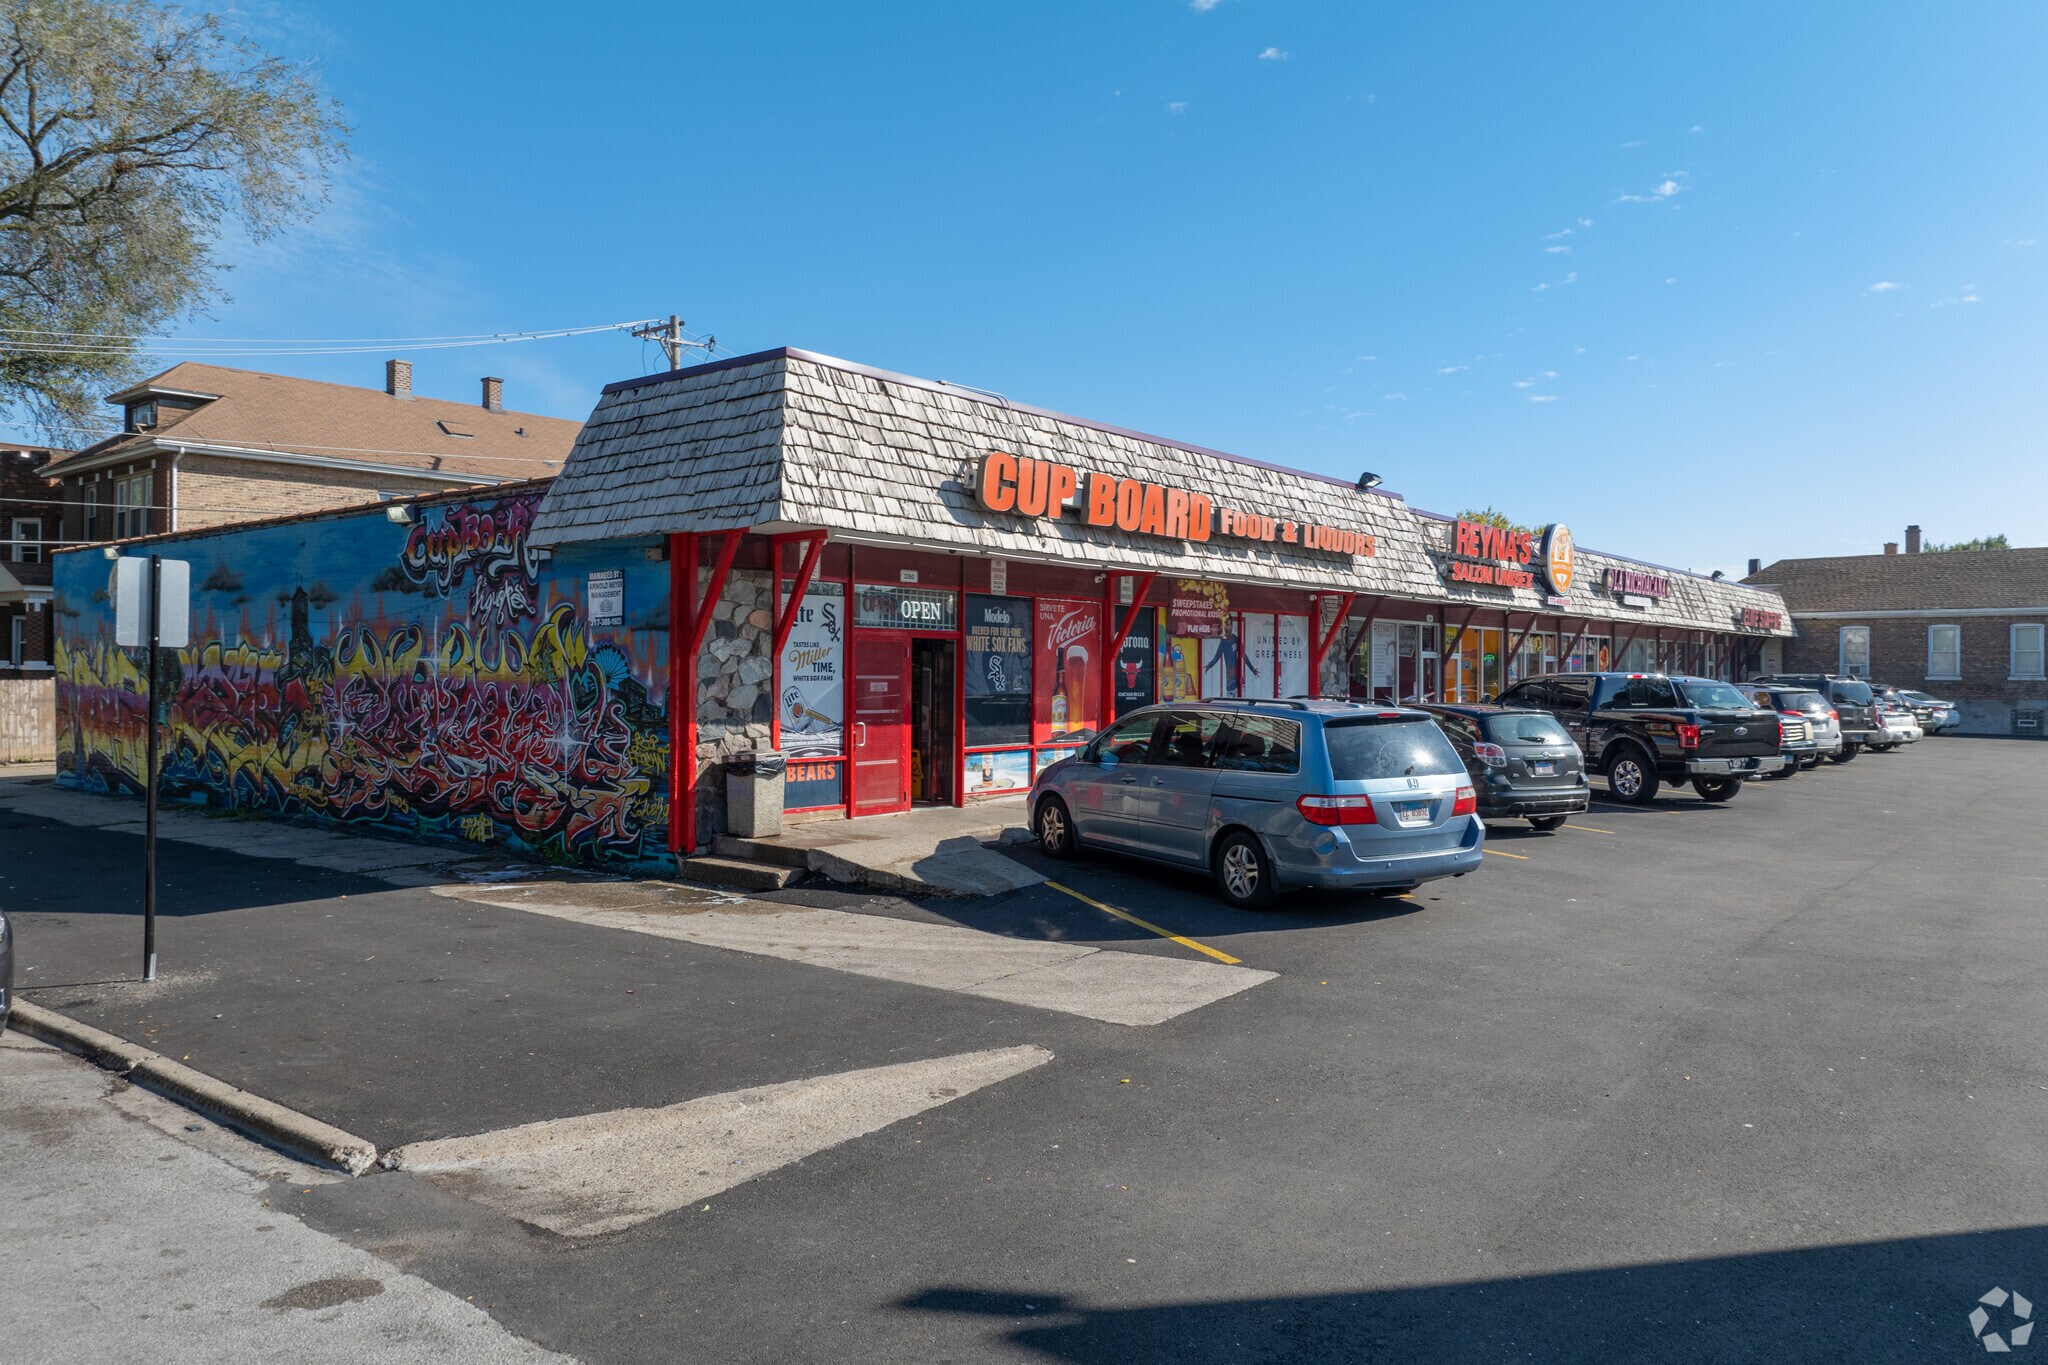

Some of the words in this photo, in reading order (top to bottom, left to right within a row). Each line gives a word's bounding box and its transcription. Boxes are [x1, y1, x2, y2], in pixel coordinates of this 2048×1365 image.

[983, 452, 1077, 519] CUP
[1088, 472, 1212, 542] BOARD
[1221, 507, 1276, 542] FOOD
[1282, 521, 1298, 543] &
[1304, 523, 1376, 558] LIQUORS
[1456, 520, 1532, 565] REYNA'S
[1452, 562, 1493, 584] SALON
[1495, 566, 1534, 589] UNISEX
[589, 582, 608, 590] ARNOLD
[591, 590, 621, 598] MANAGEMENT
[901, 600, 941, 620] OPEN
[1172, 598, 1214, 610] SWEEPSTAKES
[984, 607, 1010, 624] Modelo
[1040, 612, 1055, 621] UNA
[1171, 608, 1207, 618] PROMOTIONAL
[1047, 606, 1096, 651] Victoria
[1187, 625, 1199, 633] PLAY
[1199, 625, 1211, 633] HERE
[966, 636, 990, 652] WHITE
[991, 636, 1006, 653] SOX
[1008, 637, 1026, 653] FANS
[1291, 636, 1301, 646] BY
[788, 647, 834, 672] Miller
[1255, 650, 1302, 659] GREATNESS
[812, 662, 836, 674] TIME,
[786, 764, 836, 783] BEARS
